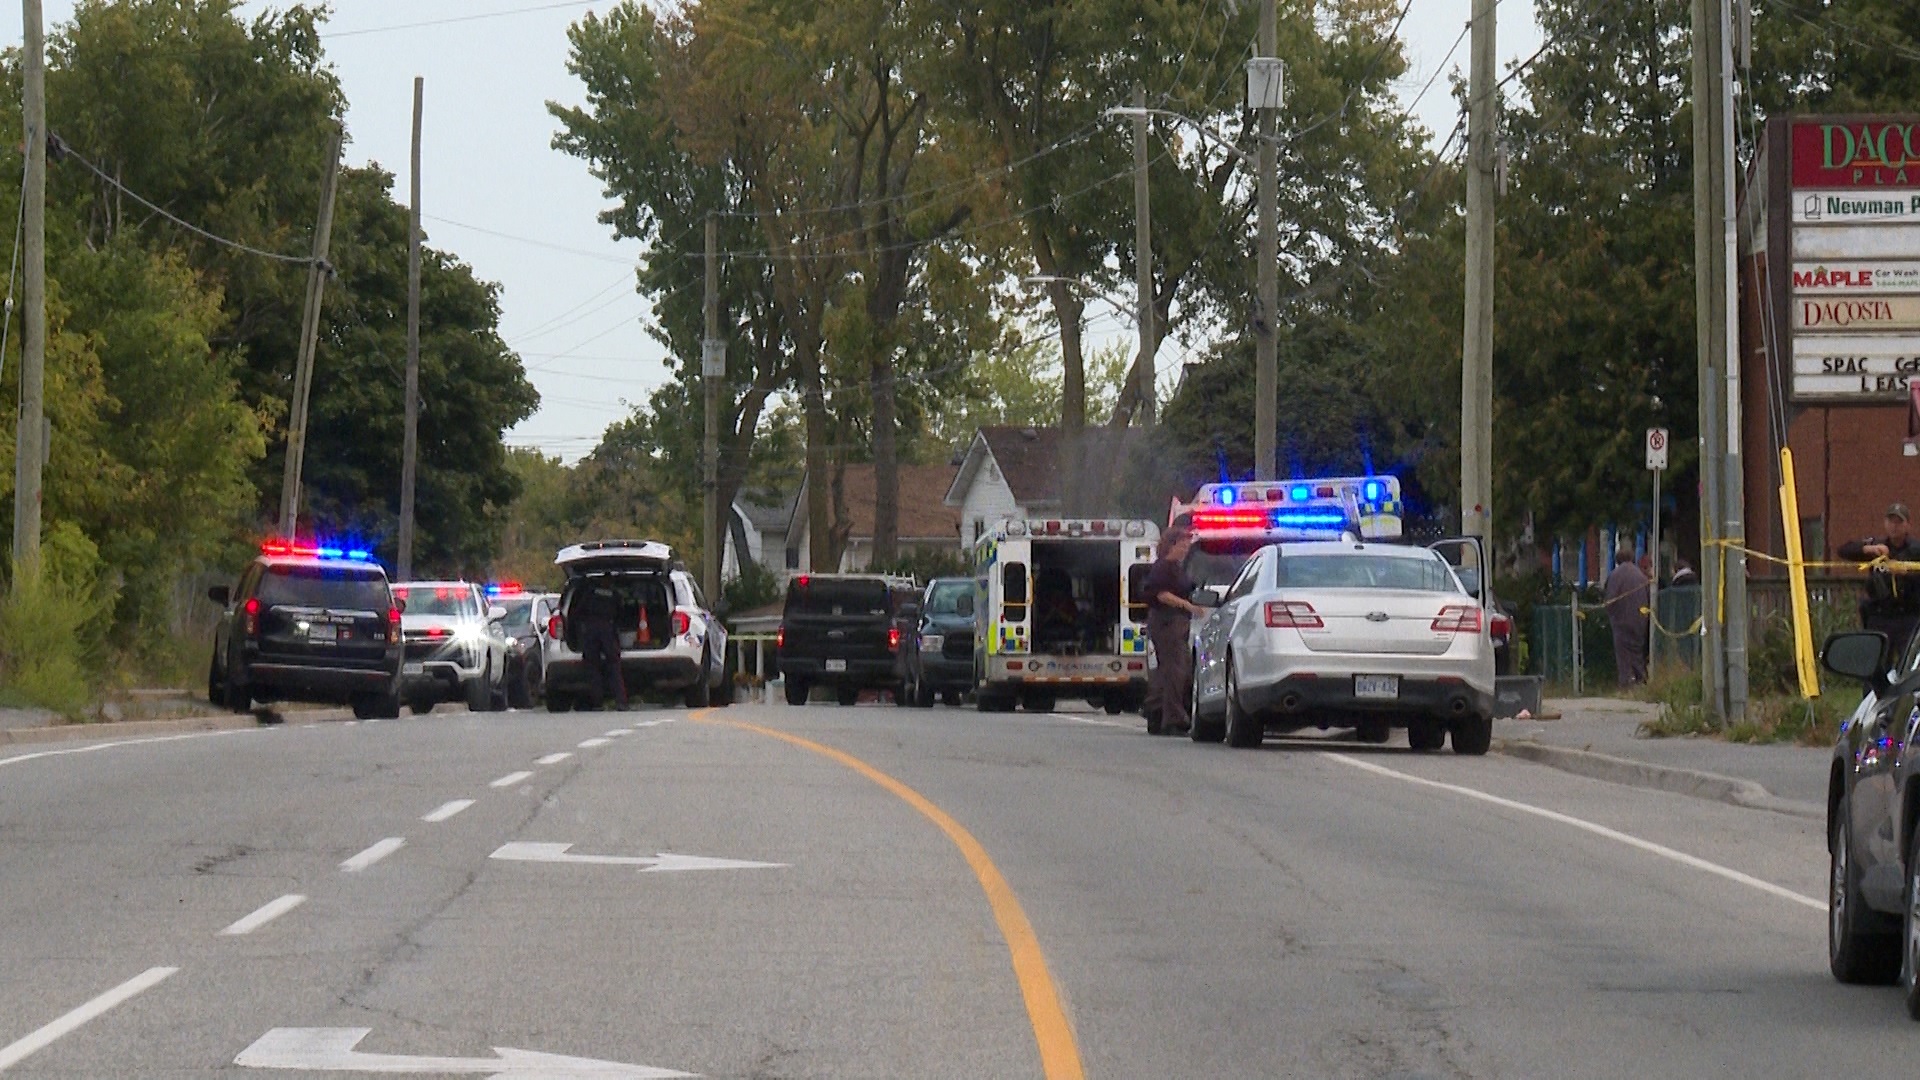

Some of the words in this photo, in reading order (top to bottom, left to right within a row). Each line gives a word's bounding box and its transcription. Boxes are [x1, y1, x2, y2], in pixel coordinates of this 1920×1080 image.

[1852, 168, 1908, 185] PLA
[1826, 196, 1904, 215] Newman
[1793, 270, 1873, 288] MAPLE
[1875, 269, 1891, 278] Car
[1893, 269, 1918, 277] Wash
[1803, 301, 1894, 327] DACOSTA
[1822, 357, 1868, 374] SPAC
